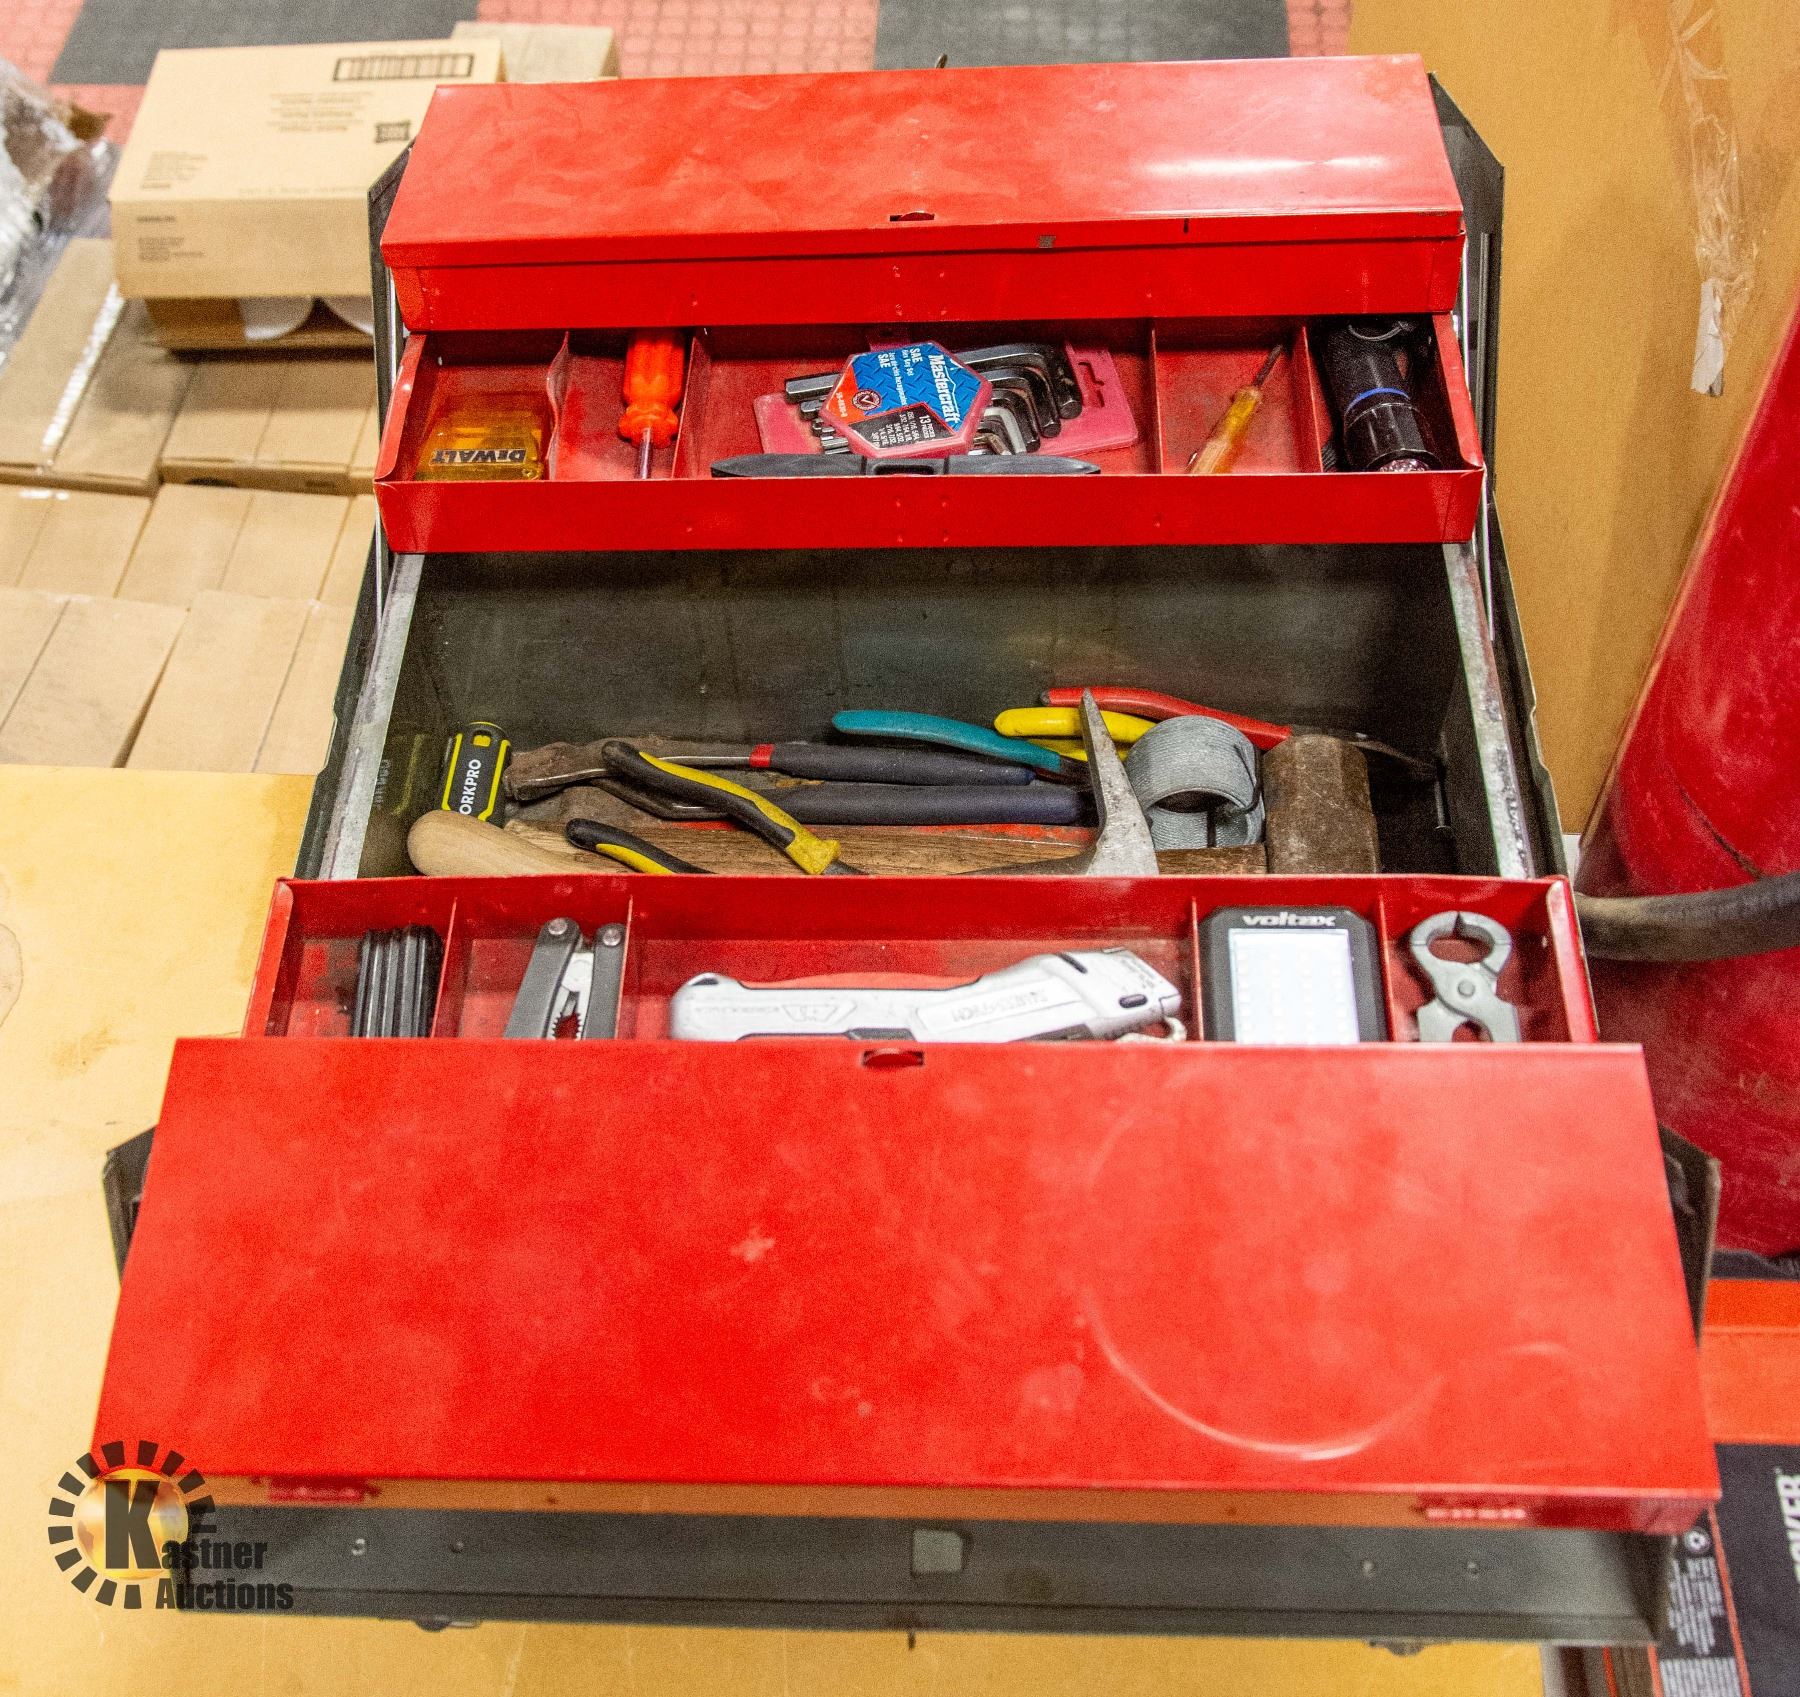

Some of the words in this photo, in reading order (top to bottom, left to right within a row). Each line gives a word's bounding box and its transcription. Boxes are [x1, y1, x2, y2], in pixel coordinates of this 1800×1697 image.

[878, 353, 891, 369] SAE
[910, 348, 923, 363] SAE
[928, 354, 961, 424] Mastercraft
[919, 415, 931, 424] 13
[459, 759, 482, 815] ORKPRO
[1243, 912, 1336, 927] voltax
